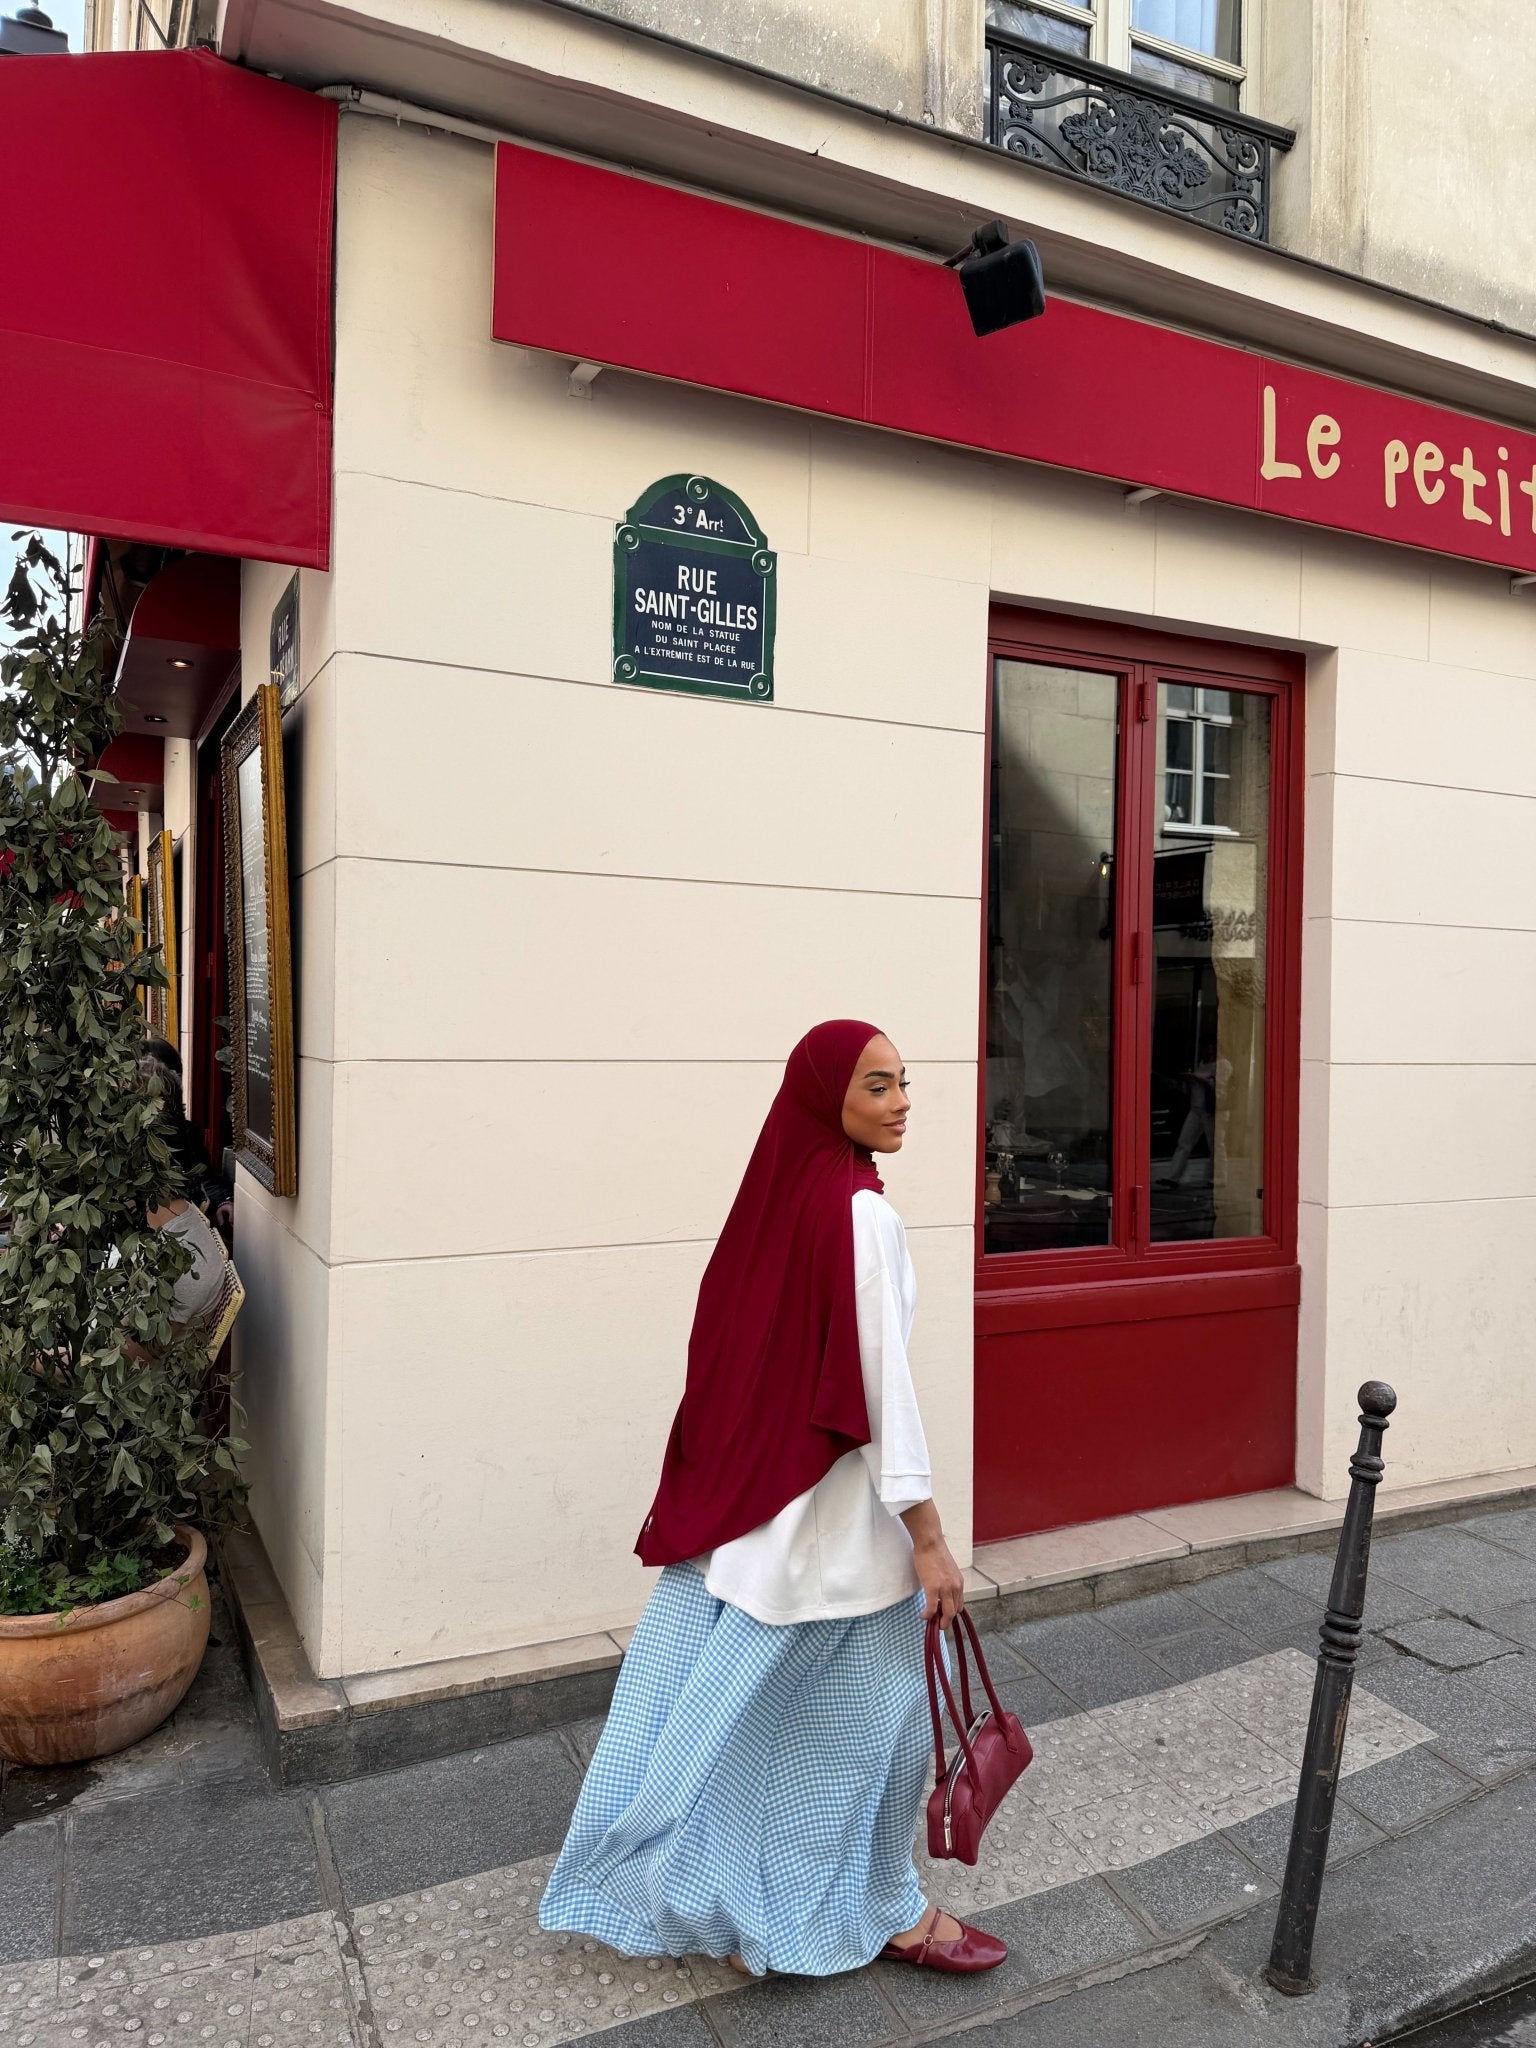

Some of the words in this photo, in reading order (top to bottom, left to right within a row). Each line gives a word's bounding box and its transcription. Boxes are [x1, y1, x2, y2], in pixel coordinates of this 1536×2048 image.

[1260, 385, 1341, 480] Le
[678, 565, 717, 595] RUE
[634, 587, 758, 631] SAINT-GILLES
[277, 614, 289, 652] RUE
[651, 620, 672, 632] NOM
[676, 625, 688, 634] DE
[692, 627, 704, 636] LA
[709, 630, 740, 642] STATUE
[655, 635, 668, 644] DU
[672, 637, 699, 648] SAINT
[634, 645, 640, 653] A
[697, 655, 711, 664] EST
[714, 657, 724, 666] DE
[727, 659, 738, 668] LA
[741, 661, 756, 671] RUE
